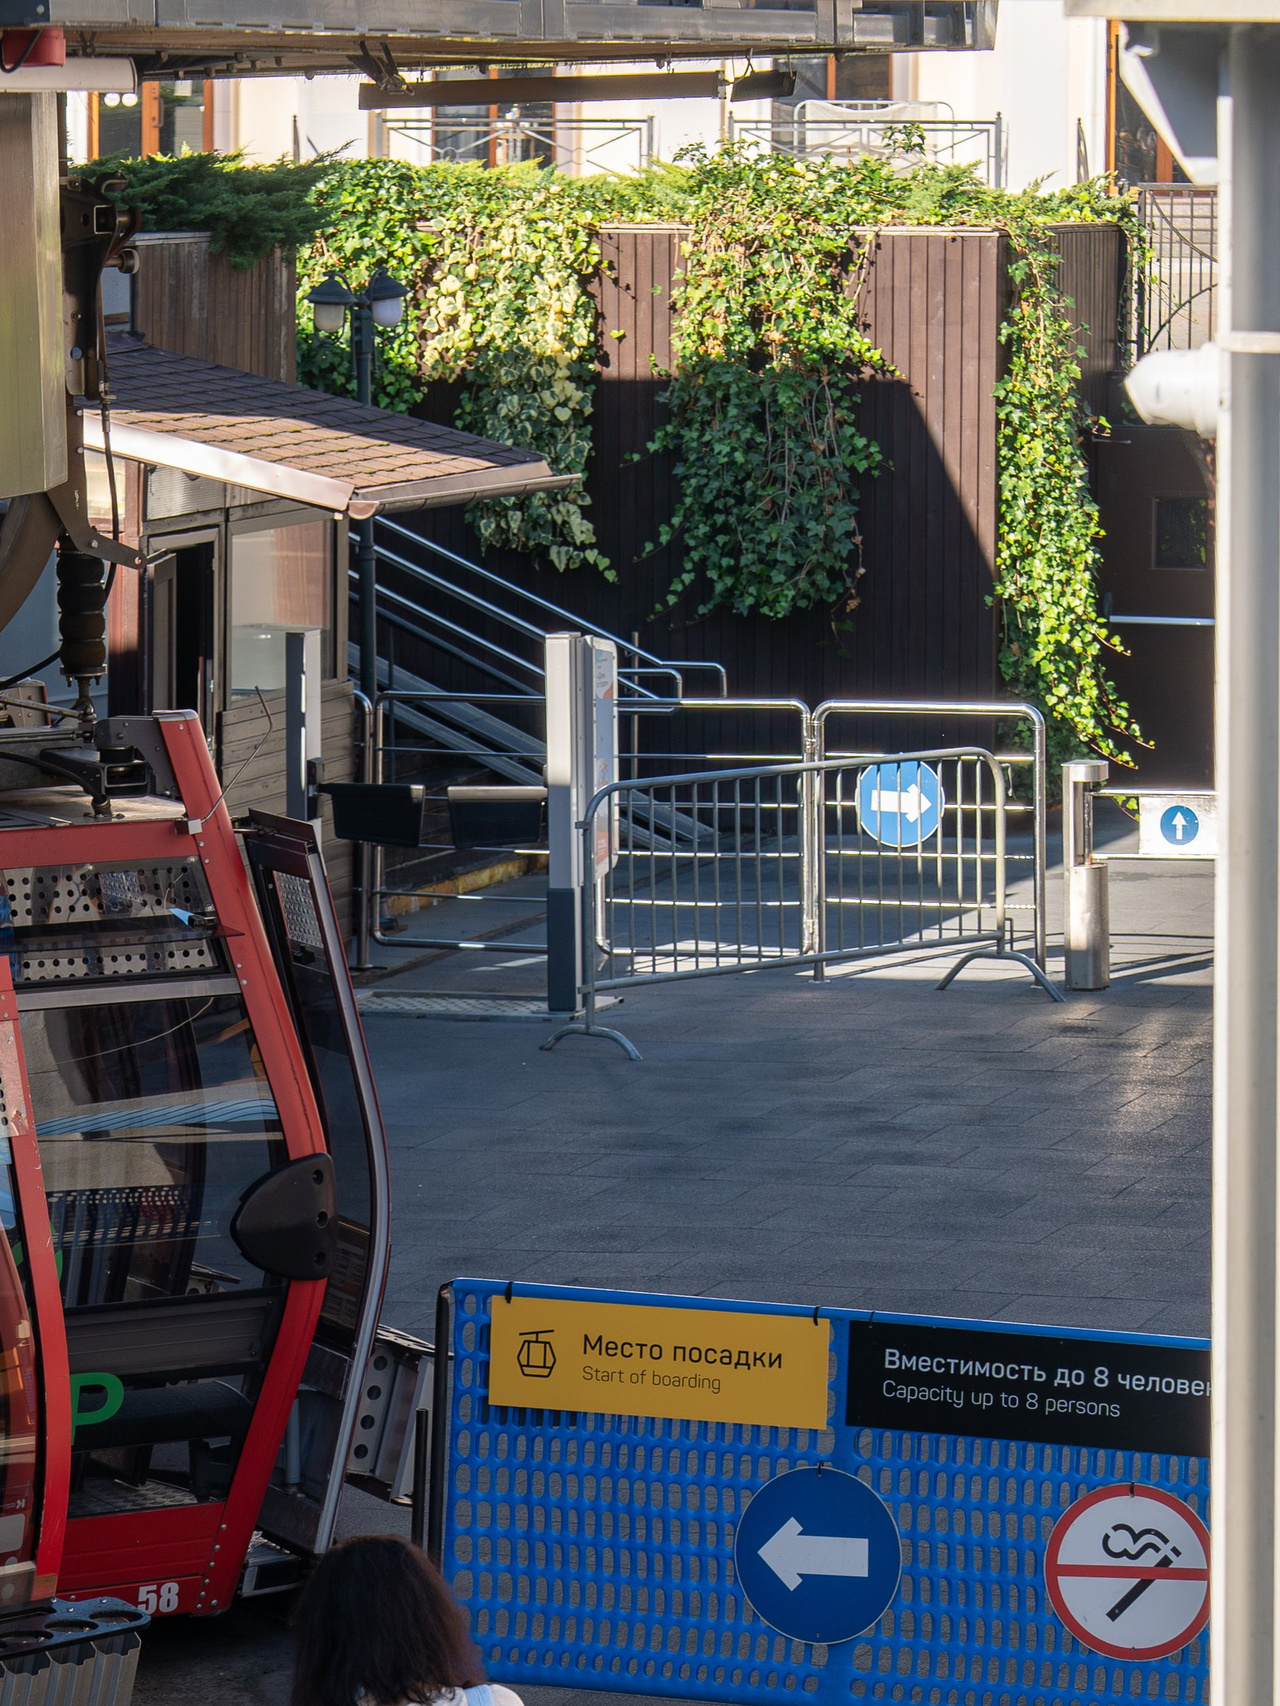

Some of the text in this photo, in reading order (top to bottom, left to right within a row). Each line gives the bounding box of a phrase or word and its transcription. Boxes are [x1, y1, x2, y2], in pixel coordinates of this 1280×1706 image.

[583, 1333, 782, 1371] Место посадки
[883, 1348, 1047, 1382] Вместимость
[1053, 1368, 1085, 1388] до
[1093, 1366, 1109, 1388] 8
[582, 1365, 721, 1395] Start of boarding
[882, 1379, 1121, 1418] Capacity up to 8 persons
[137, 1581, 179, 1615] 58
